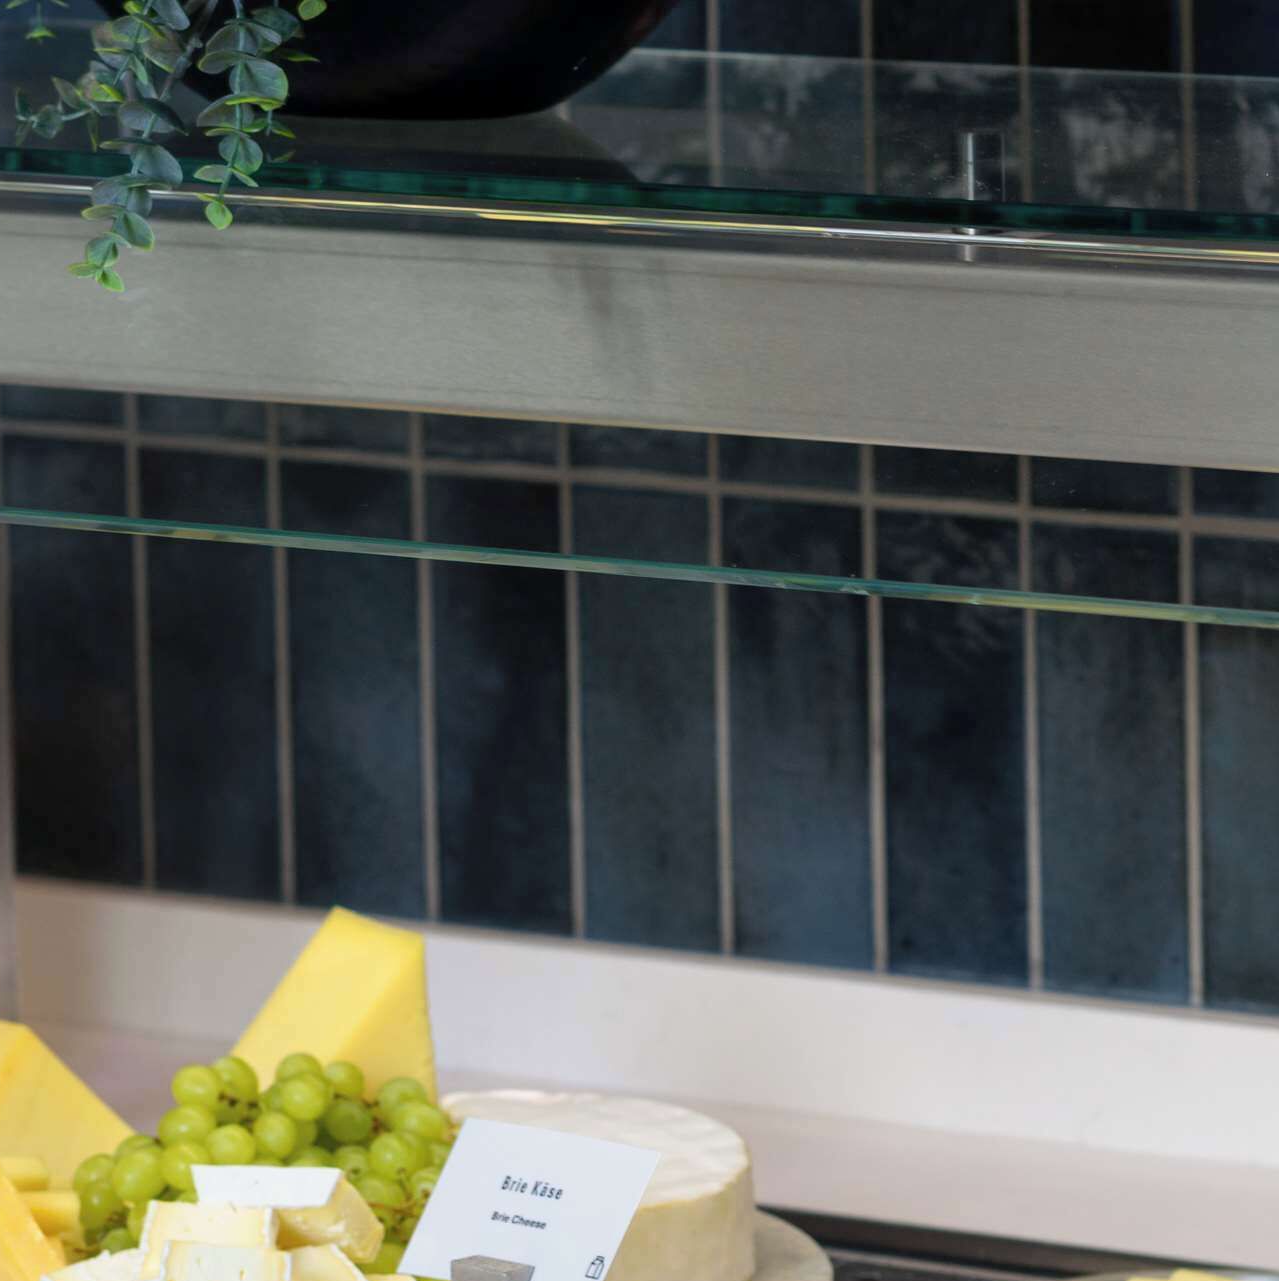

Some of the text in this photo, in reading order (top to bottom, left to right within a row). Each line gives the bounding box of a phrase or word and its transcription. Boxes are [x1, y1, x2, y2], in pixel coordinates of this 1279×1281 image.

[501, 1175, 563, 1200] Brie Käse
[490, 1210, 547, 1230] Brie Cheese
